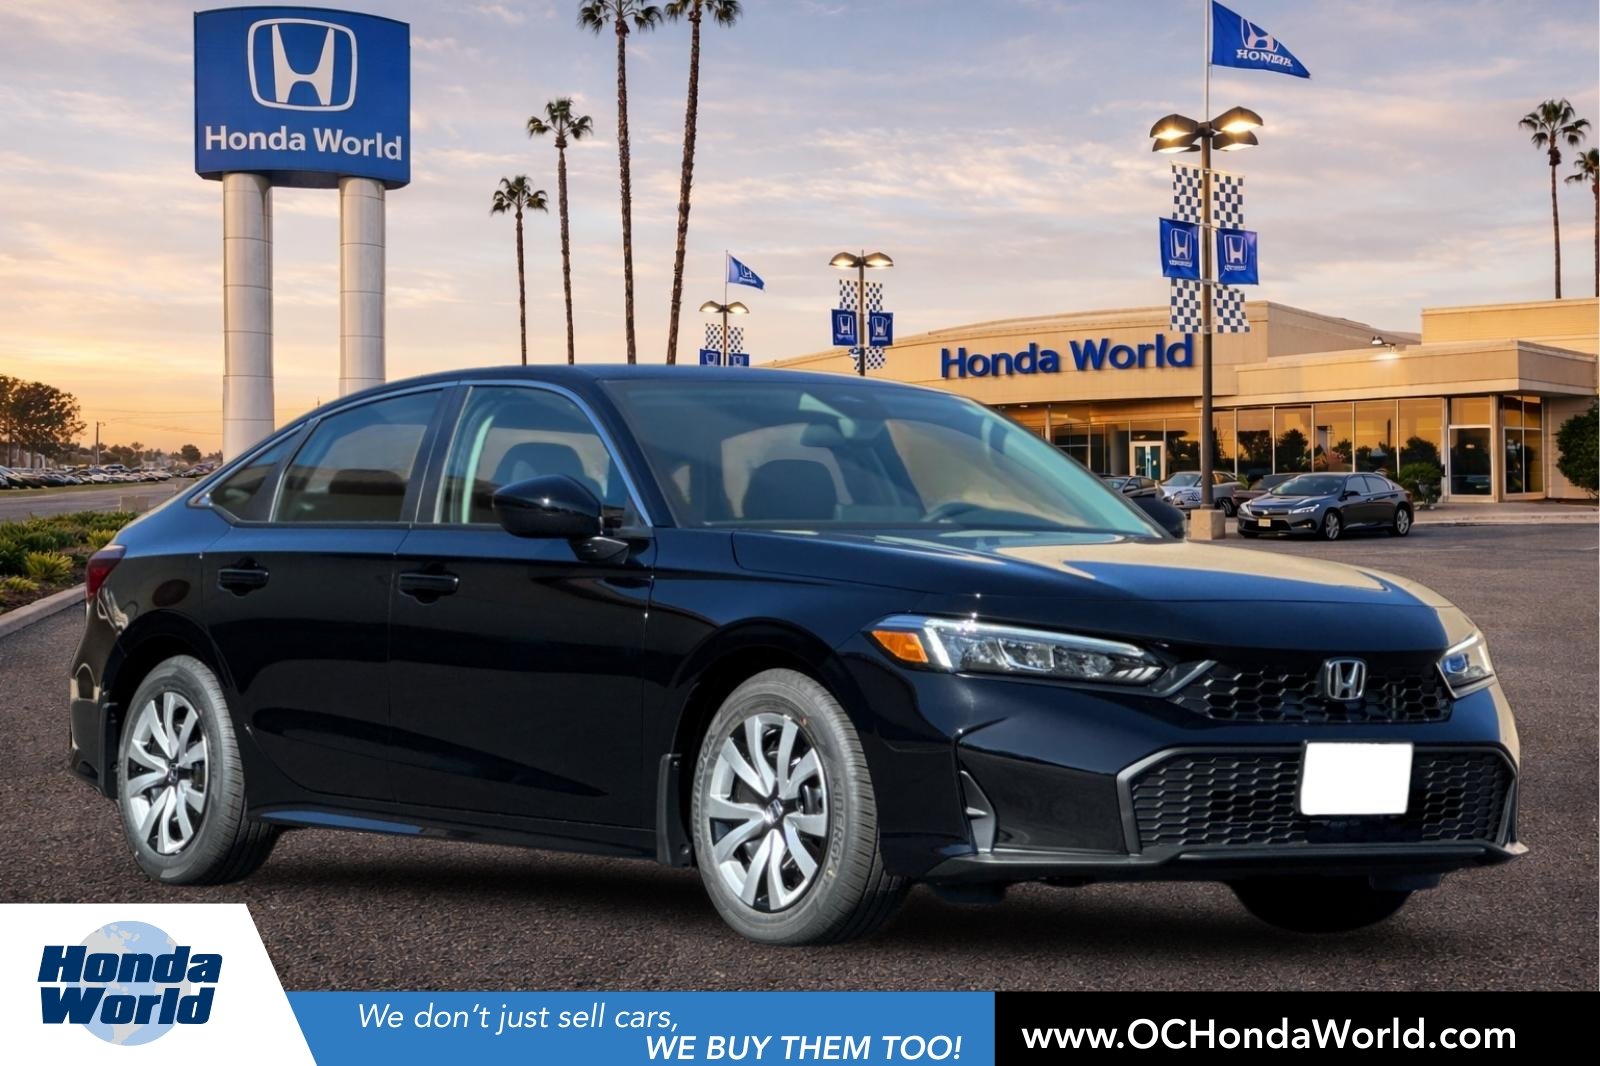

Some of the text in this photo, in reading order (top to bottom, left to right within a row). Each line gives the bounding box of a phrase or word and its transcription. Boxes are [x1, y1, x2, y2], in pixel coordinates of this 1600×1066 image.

[205, 125, 402, 161] Honda World
[941, 333, 1194, 379] Honda World
